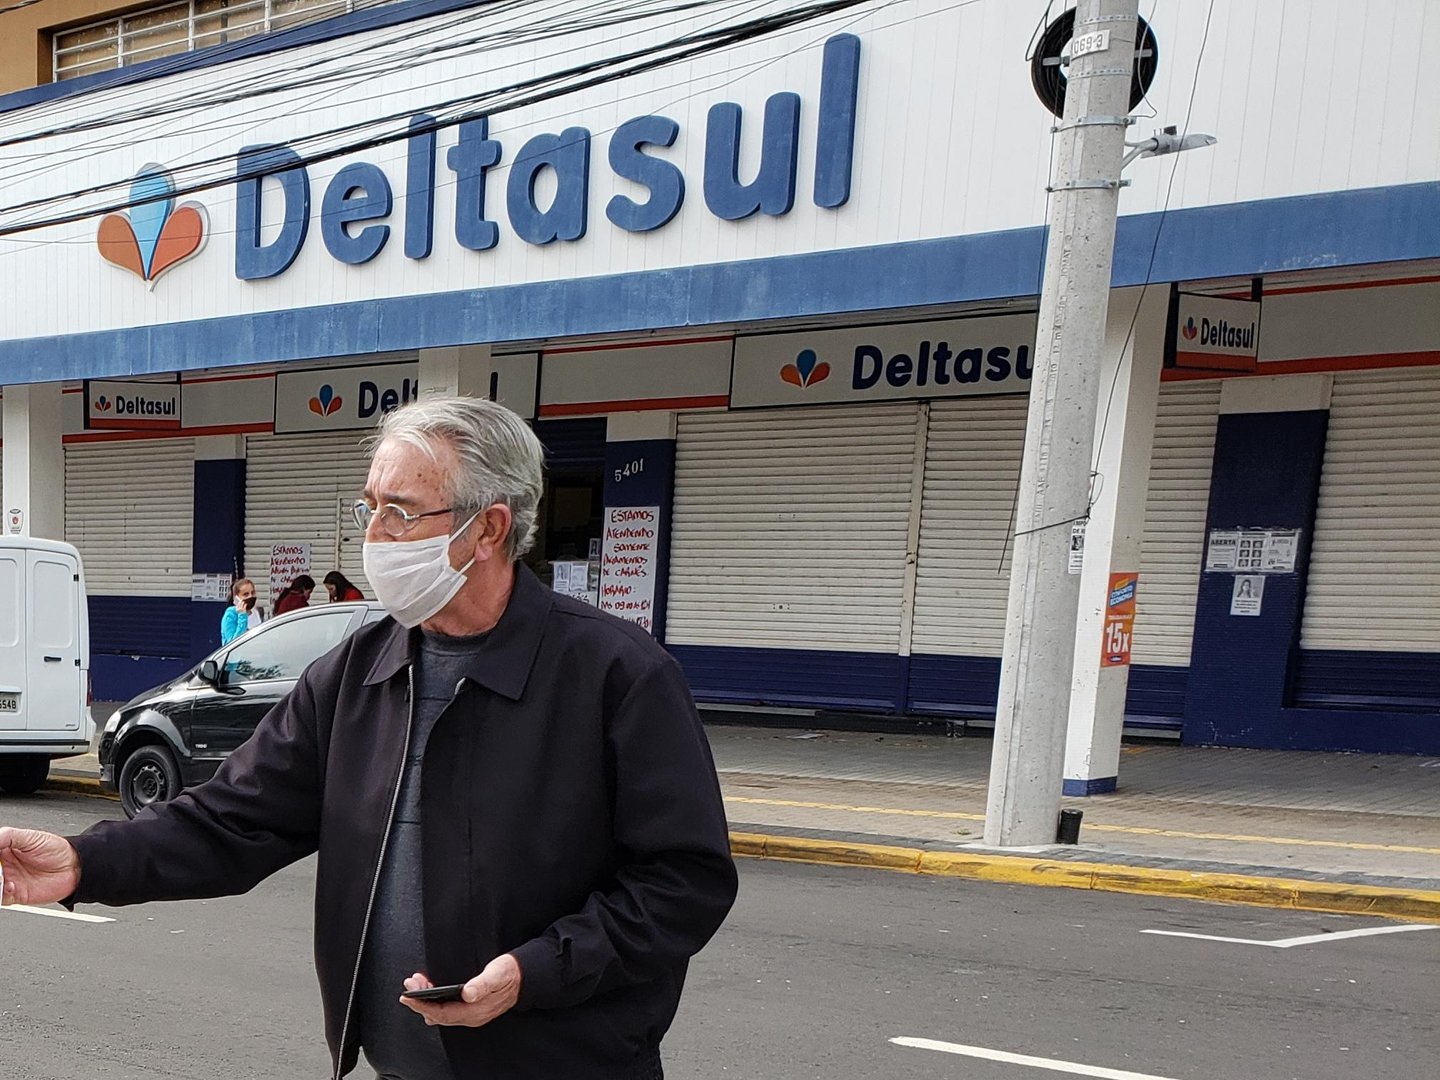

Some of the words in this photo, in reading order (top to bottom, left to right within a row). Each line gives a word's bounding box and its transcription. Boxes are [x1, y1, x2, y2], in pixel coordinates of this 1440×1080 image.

[234, 32, 862, 281] Deltasul
[1201, 318, 1255, 349] Deltasul
[852, 341, 1033, 390] Deltasu
[116, 396, 176, 415] Deltasul
[614, 458, 644, 482] 5401
[611, 510, 655, 523] ESTAMOS
